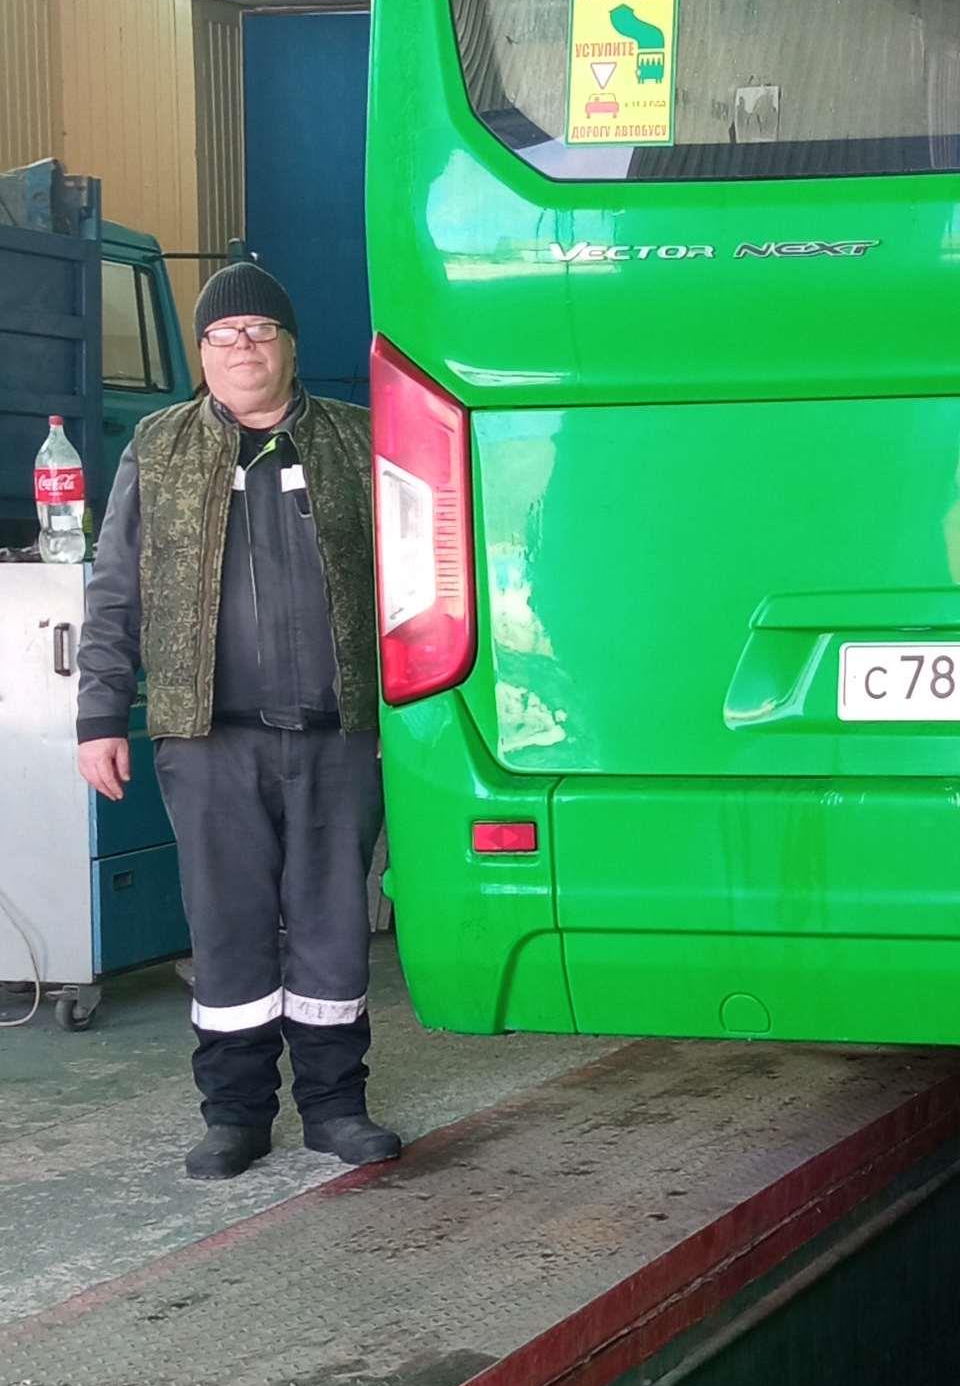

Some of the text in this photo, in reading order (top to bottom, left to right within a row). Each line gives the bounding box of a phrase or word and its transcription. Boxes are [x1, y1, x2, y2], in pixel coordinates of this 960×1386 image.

[575, 42, 635, 58] УСТУПИТЕ
[571, 124, 667, 139] ДОРОГУ АВТОБУСУ
